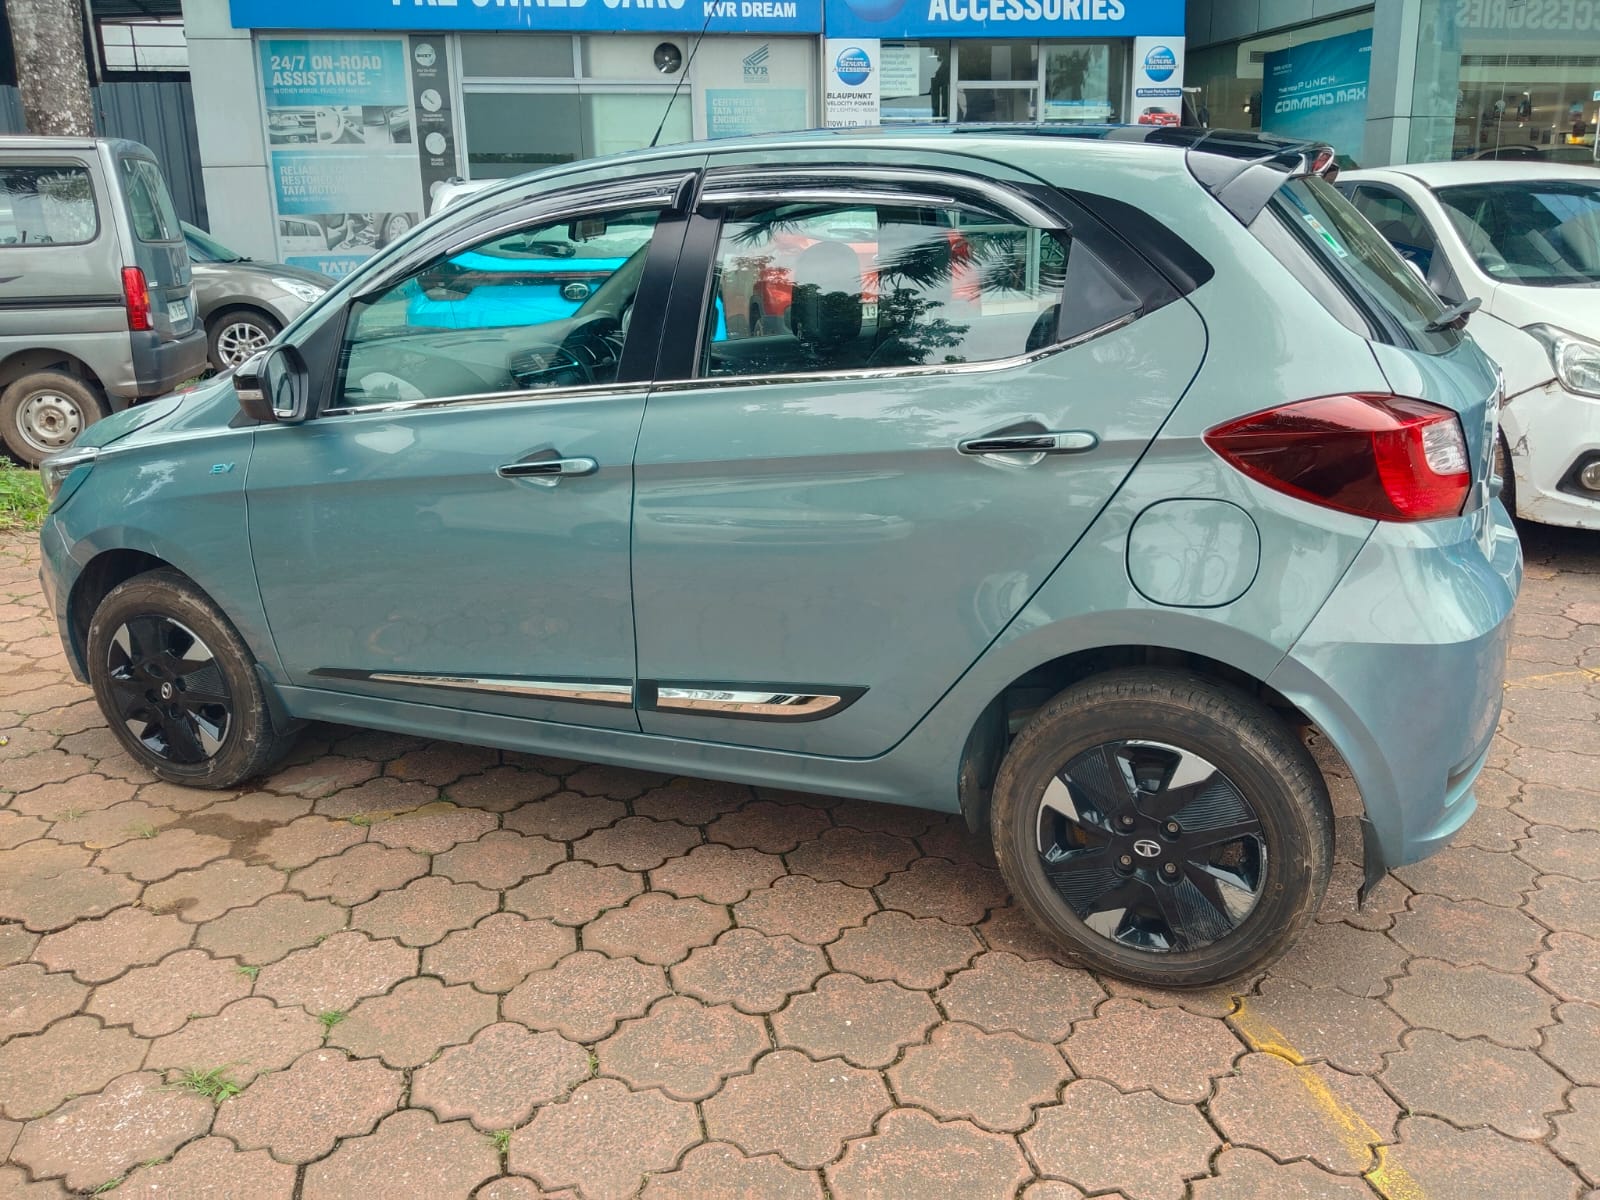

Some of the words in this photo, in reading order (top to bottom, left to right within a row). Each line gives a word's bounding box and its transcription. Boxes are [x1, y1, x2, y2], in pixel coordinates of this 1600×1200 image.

[703, 2, 737, 17] KVR
[741, 2, 797, 17] DREAM
[928, 0, 1125, 21] ACCESSORIES
[270, 55, 306, 72] 24/7
[311, 55, 381, 70] ON-ROAD
[743, 66, 768, 75] KVR
[272, 71, 372, 86] ASSISTANCE.
[1297, 75, 1336, 91] PUNCH
[1274, 92, 1334, 114] COMMAND
[1336, 87, 1366, 103] MAX
